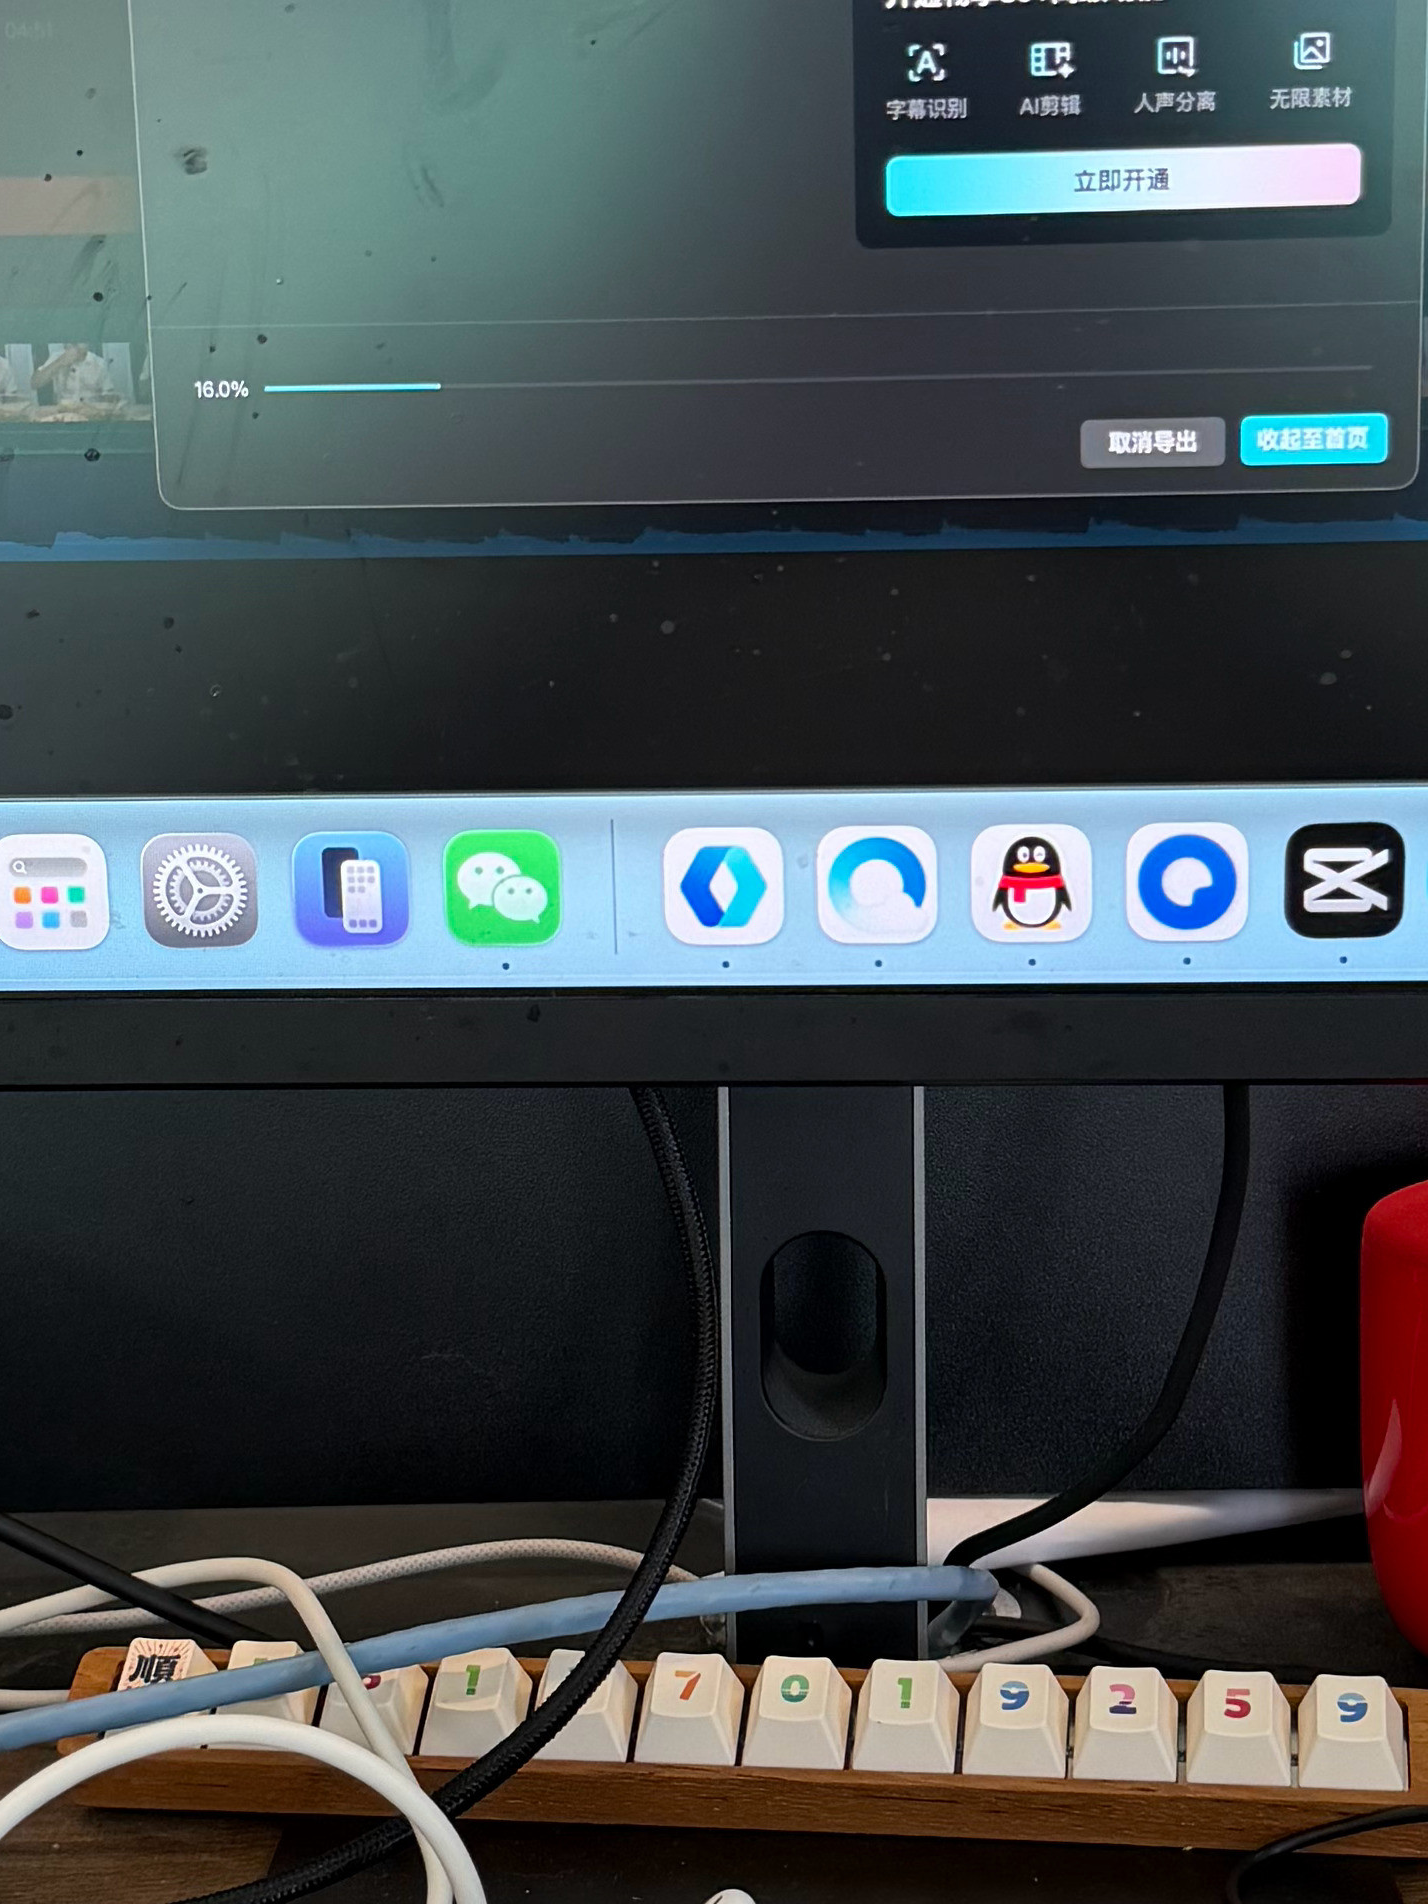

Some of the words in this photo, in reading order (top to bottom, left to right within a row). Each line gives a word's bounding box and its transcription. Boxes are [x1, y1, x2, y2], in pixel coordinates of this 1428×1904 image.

[886, 96, 967, 121] 字幕识别
[1019, 93, 1081, 117] AI剪辑
[1134, 89, 1217, 115] 人声分离
[1270, 85, 1352, 110] 无限素材
[1073, 165, 1170, 195] 立即开通
[194, 380, 249, 399] 16.0%
[1108, 429, 1197, 454] 取消导出
[1256, 425, 1370, 452] 收起至首页
[675, 1669, 702, 1701] 7
[781, 1674, 810, 1703] 0
[897, 1677, 913, 1708] 1
[1001, 1681, 1031, 1711] 9
[1109, 1683, 1137, 1714] 2
[1224, 1688, 1251, 1719] 5
[1337, 1692, 1369, 1723] 9
